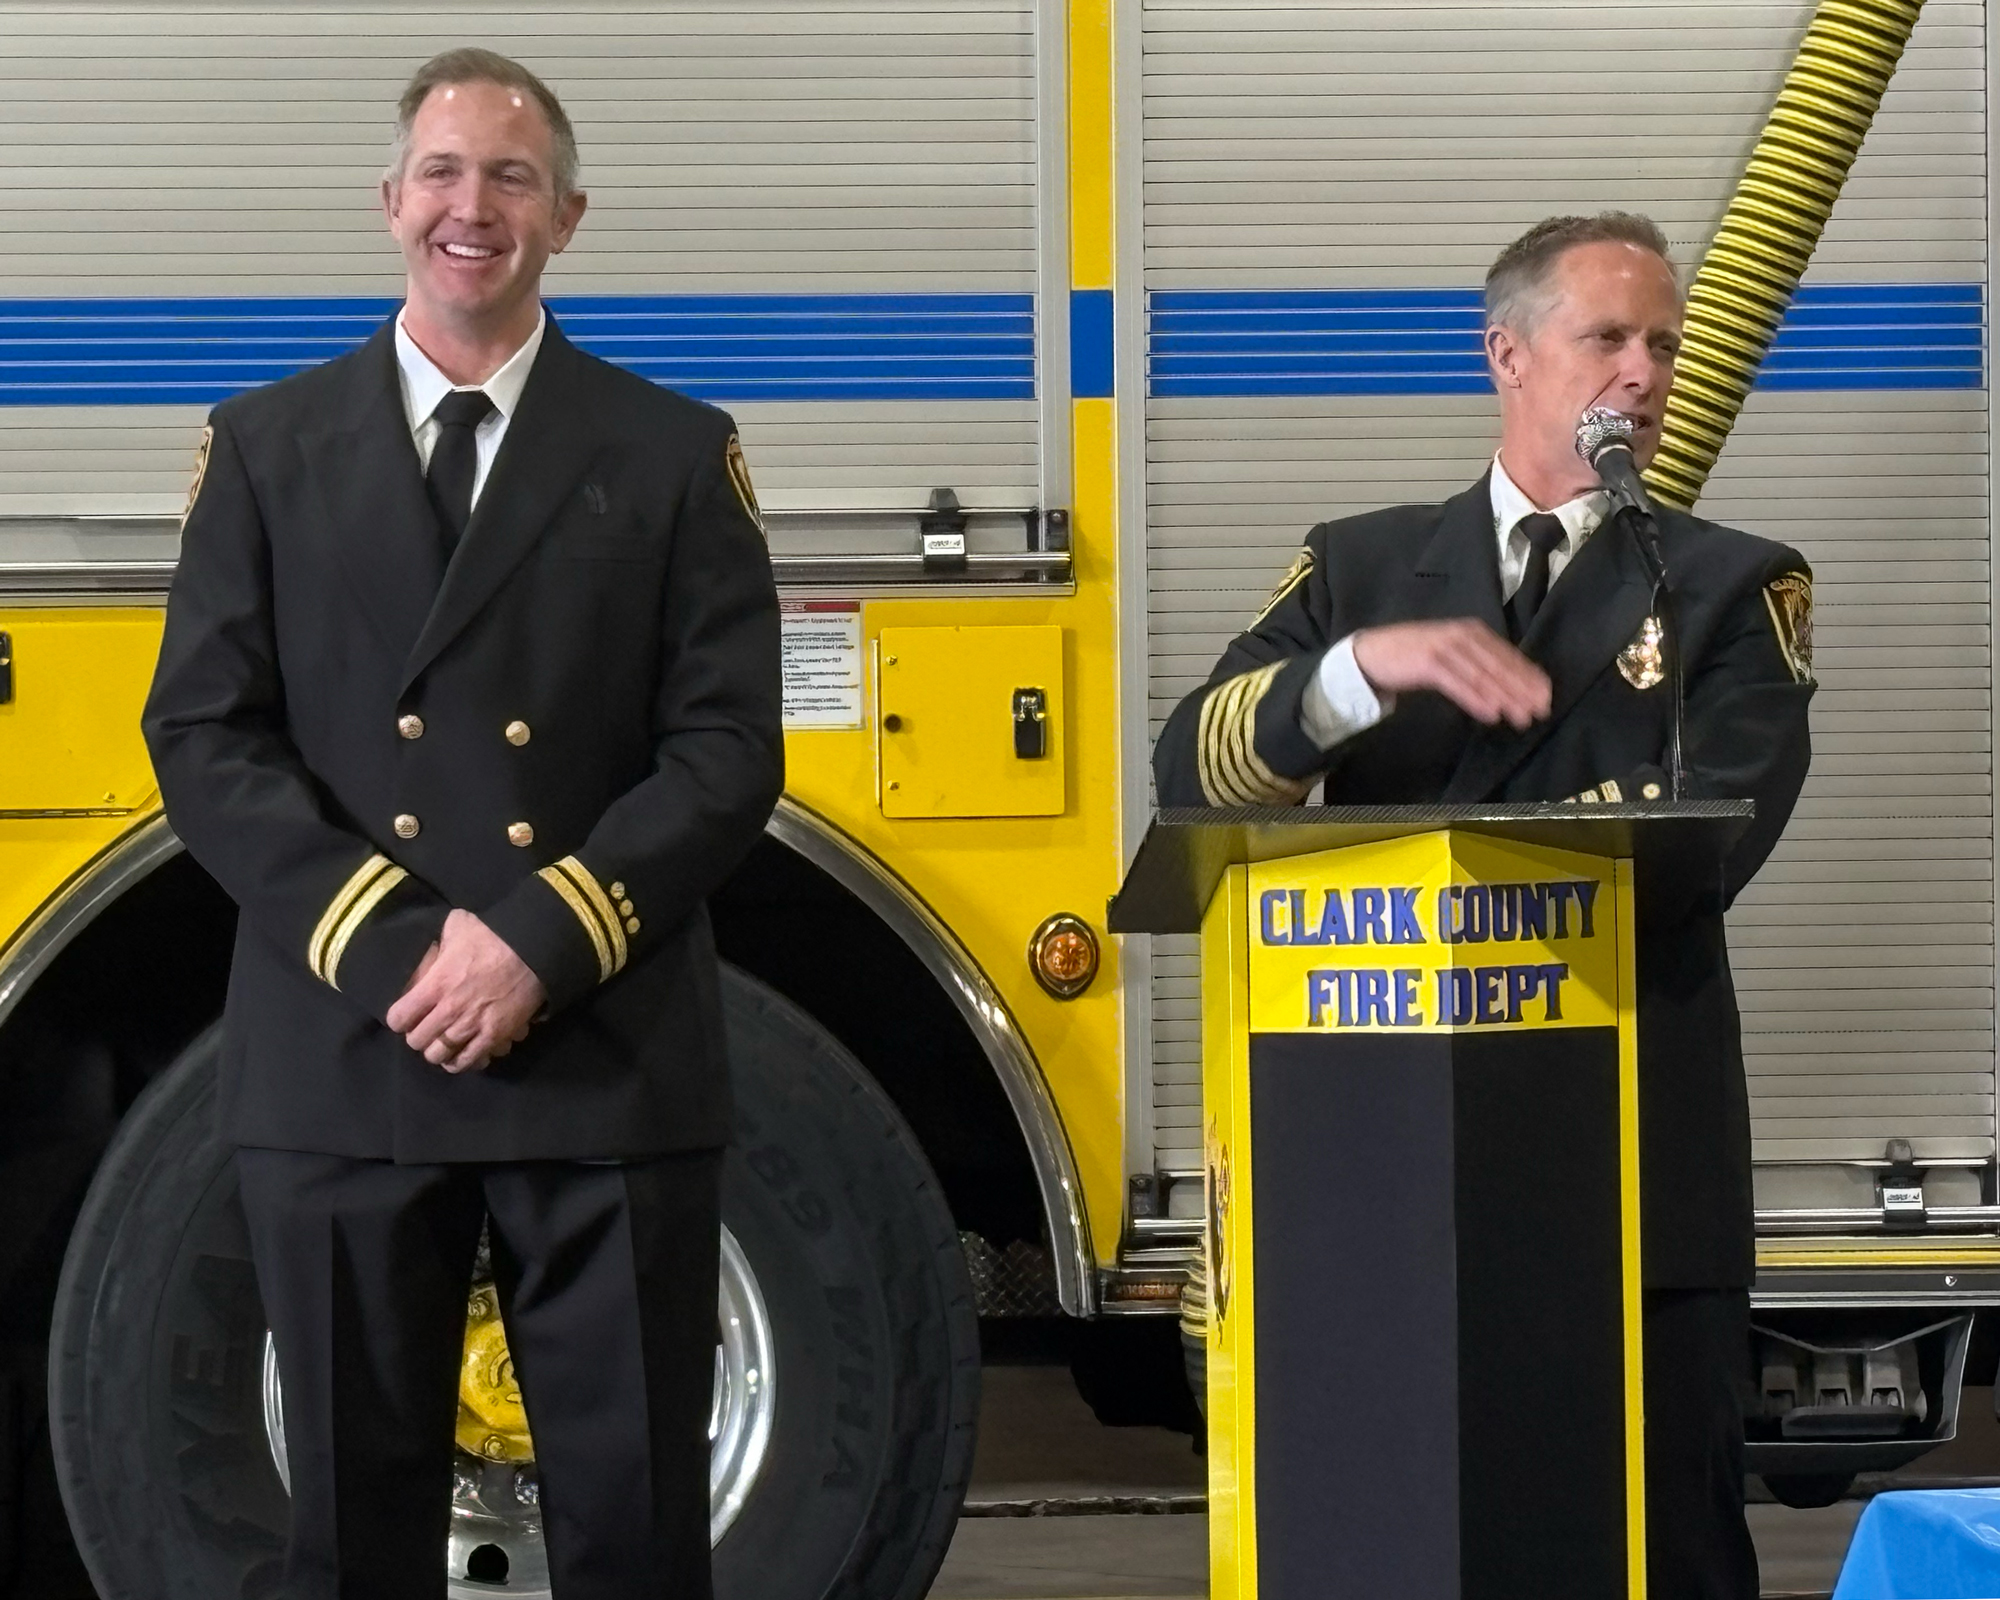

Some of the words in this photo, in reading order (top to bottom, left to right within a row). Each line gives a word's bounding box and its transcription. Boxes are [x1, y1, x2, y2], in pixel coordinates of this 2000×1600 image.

[1260, 886, 1427, 946] CLARK
[1438, 880, 1601, 944] COUNTY
[1307, 967, 1424, 1028] FIRE
[1434, 963, 1570, 1027] DEPT
